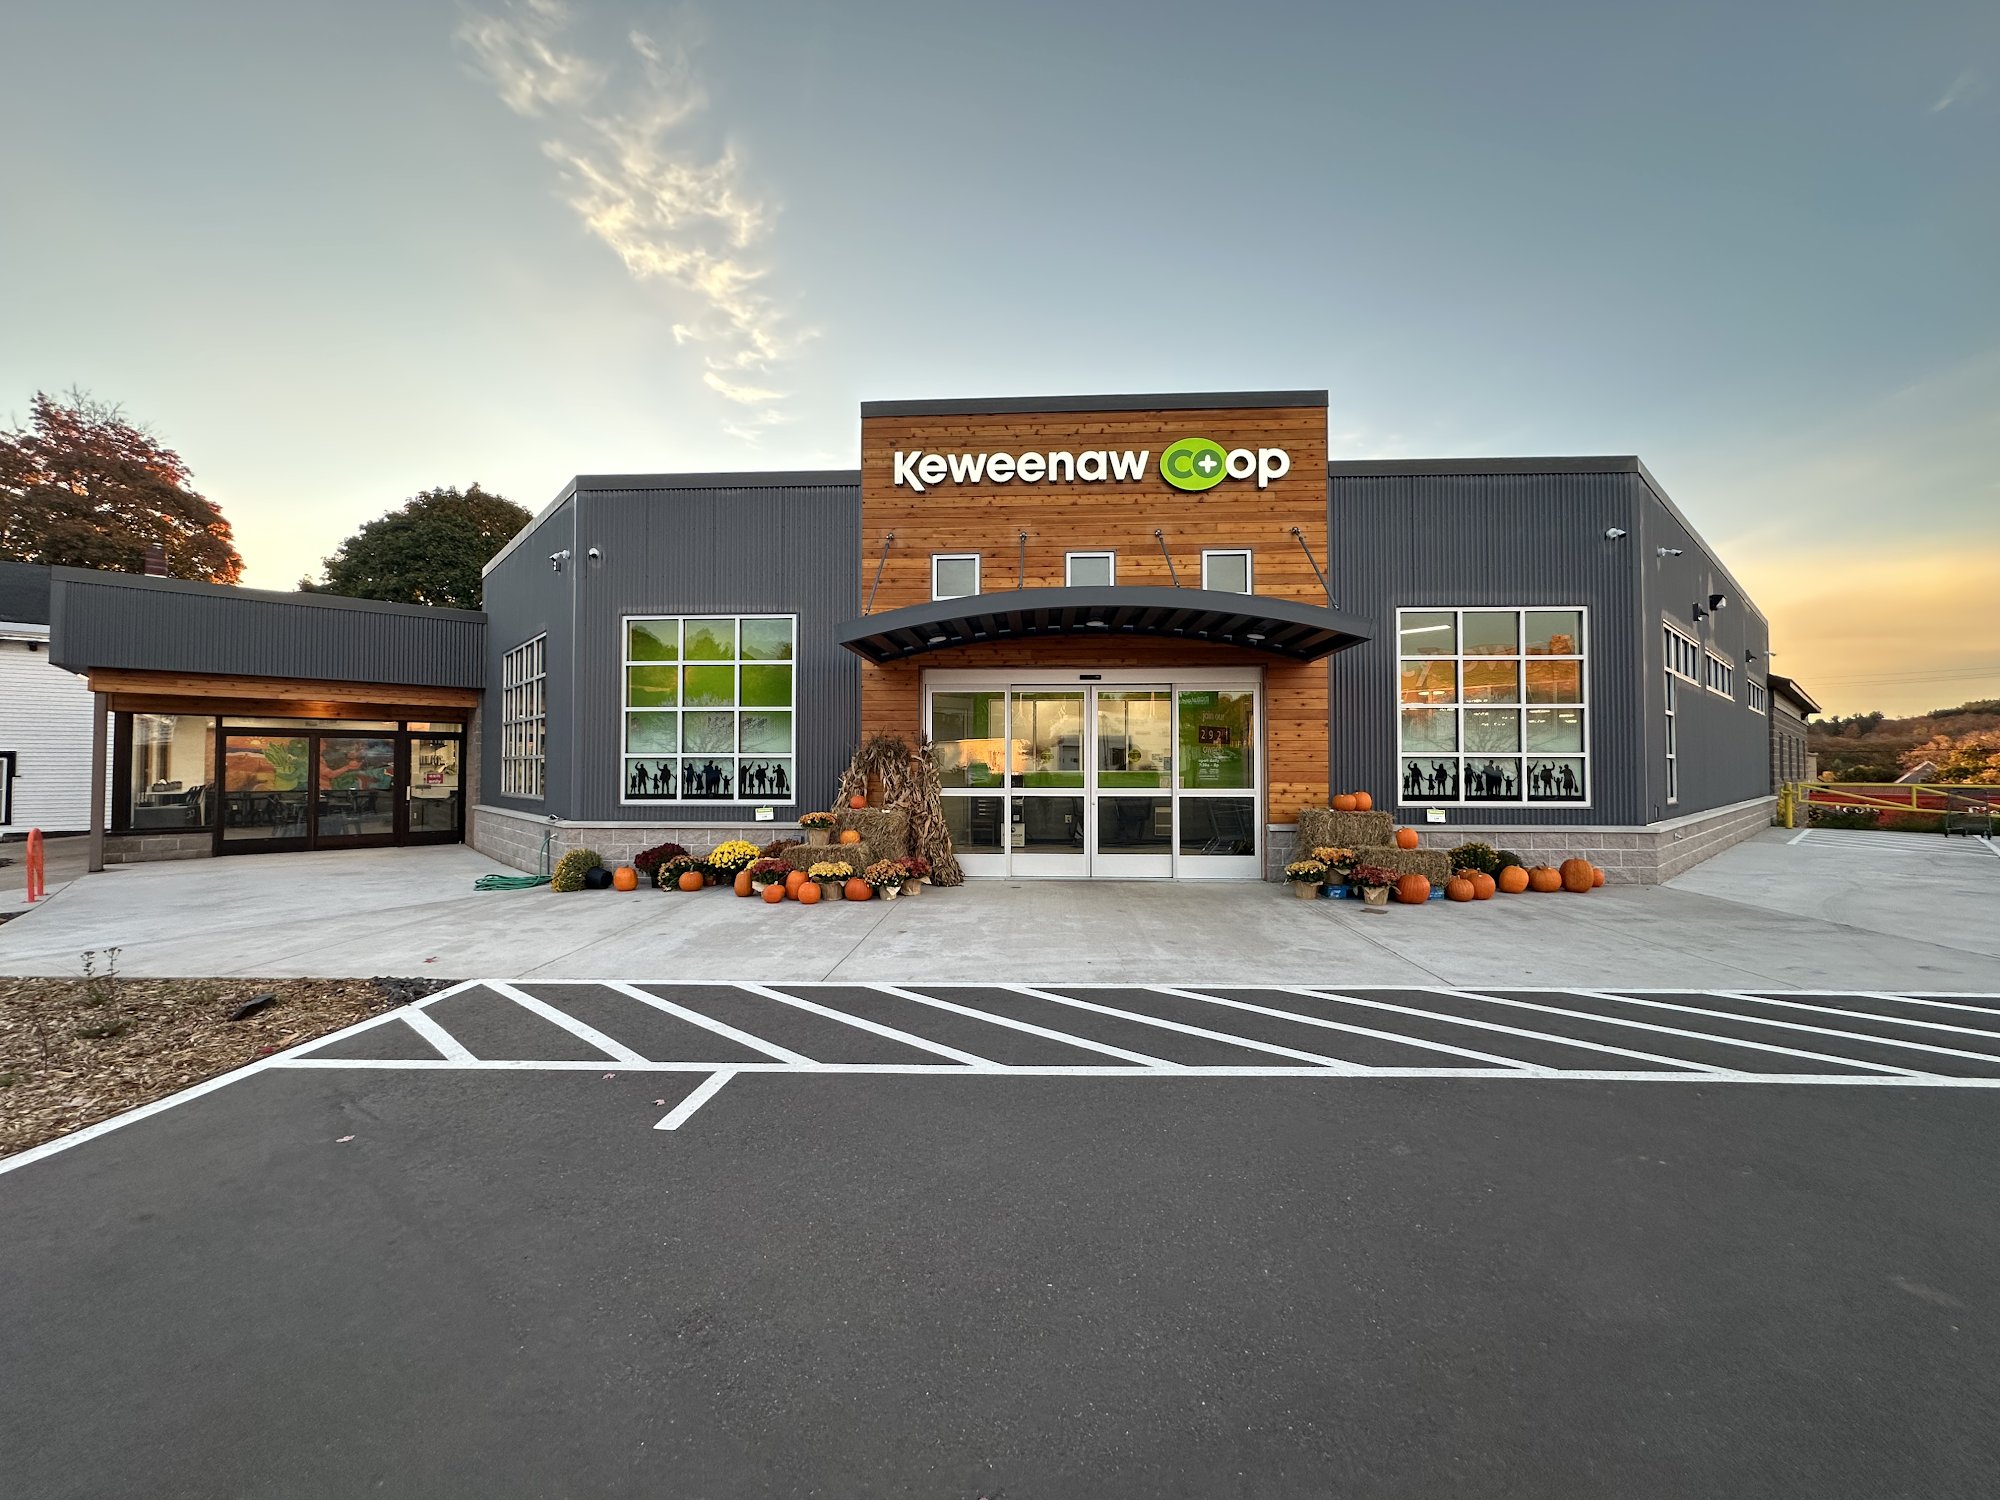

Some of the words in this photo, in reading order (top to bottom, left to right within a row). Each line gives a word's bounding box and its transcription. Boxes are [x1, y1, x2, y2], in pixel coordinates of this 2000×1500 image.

[894, 450, 1149, 491] Keweenaw
[1202, 710, 1215, 722] join
[1215, 712, 1225, 721] our
